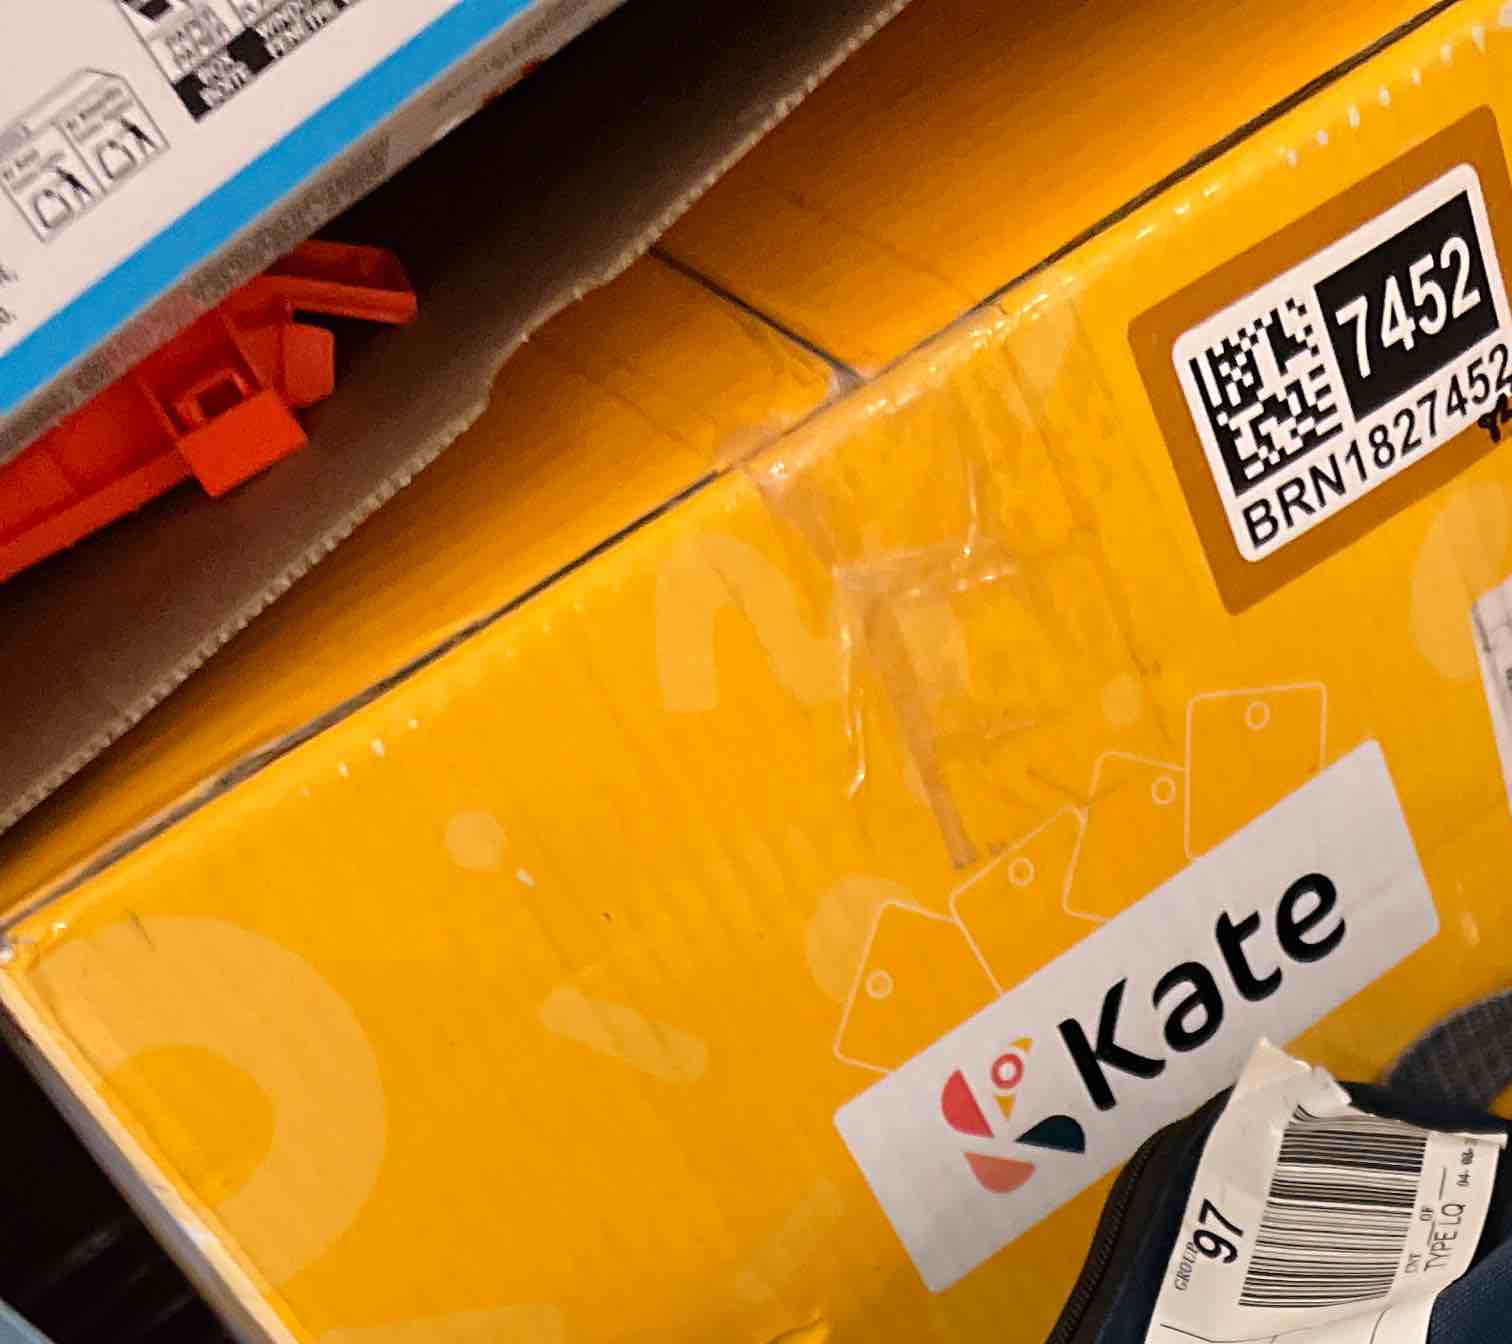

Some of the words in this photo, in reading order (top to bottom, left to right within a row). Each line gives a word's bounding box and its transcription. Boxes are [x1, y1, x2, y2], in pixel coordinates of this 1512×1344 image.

[1336, 235, 1484, 379] 7452
[1058, 871, 1349, 1112] Kate
[1173, 1241, 1199, 1291] GROUP
[1189, 1197, 1245, 1265] 97
[1422, 1229, 1456, 1271] TYPE
[1437, 1201, 1466, 1226] LQ
